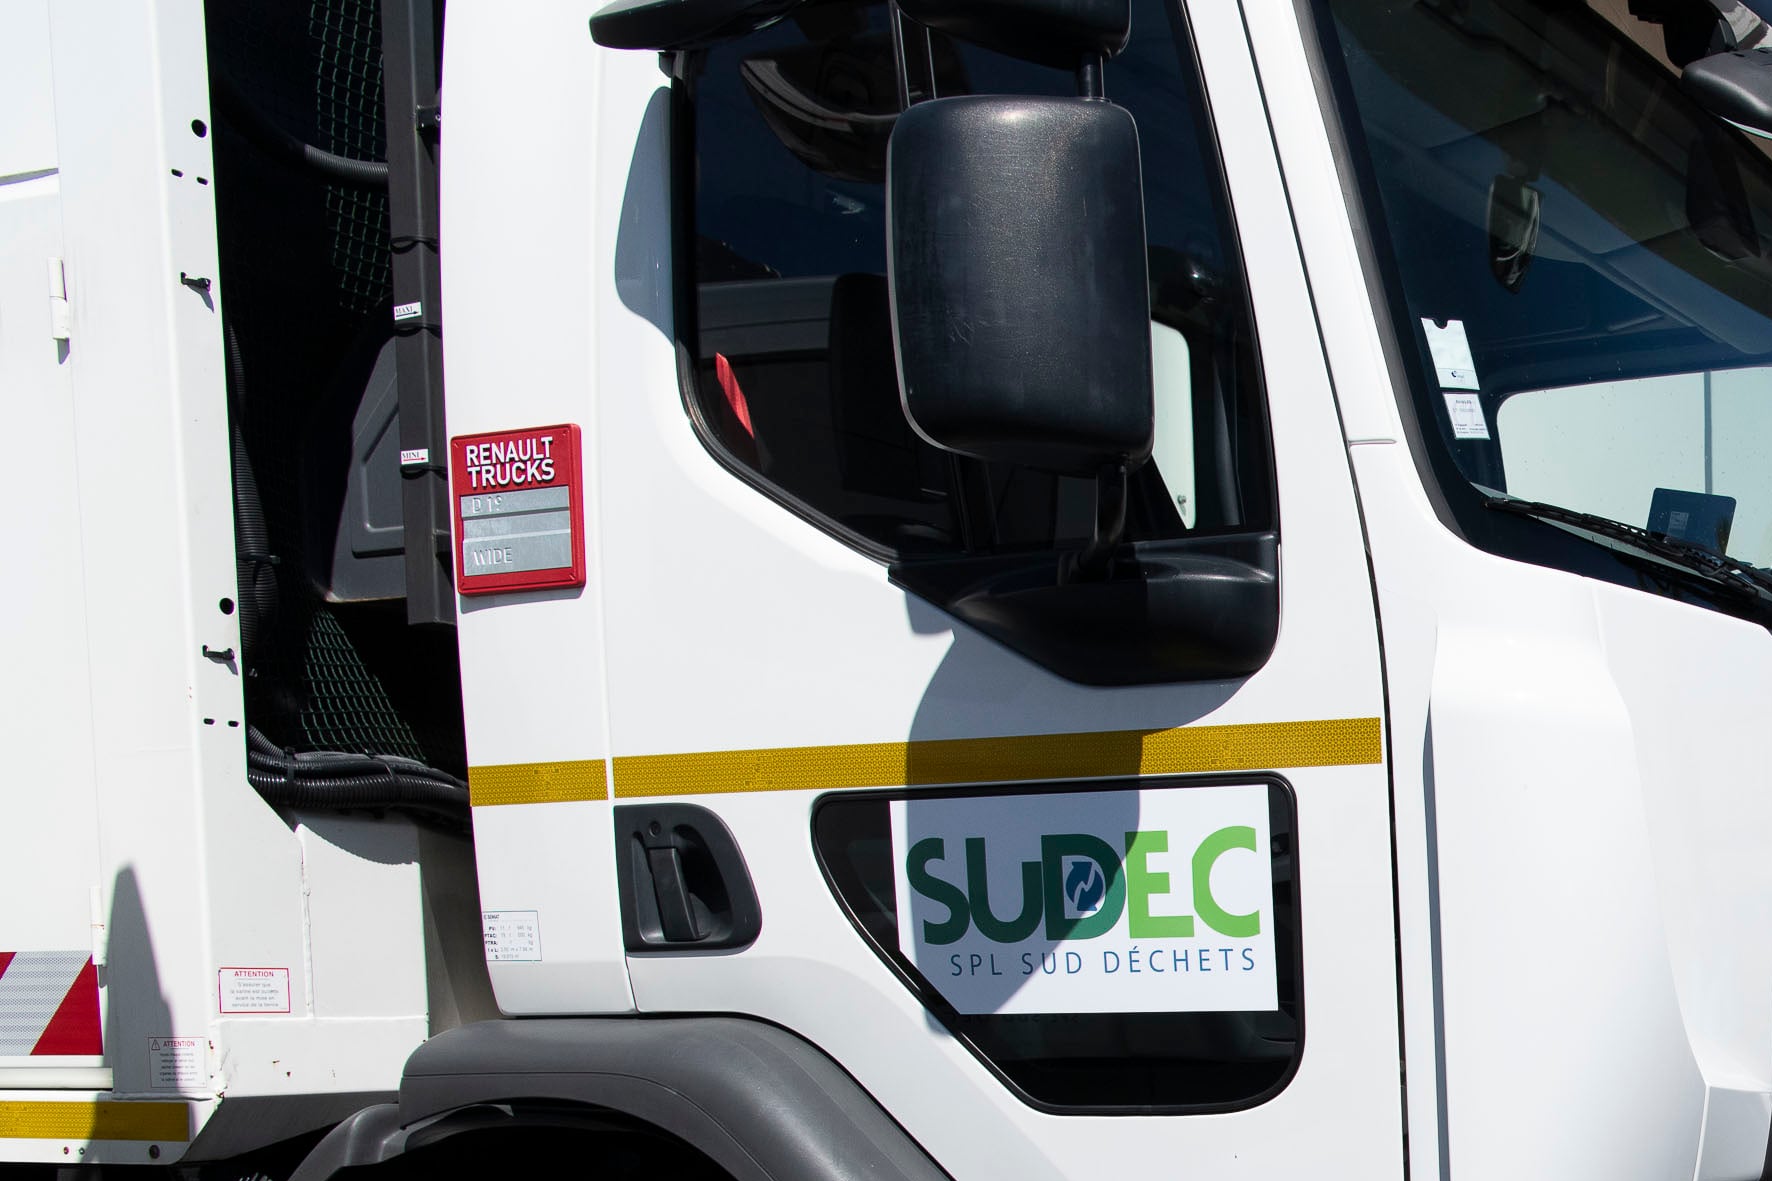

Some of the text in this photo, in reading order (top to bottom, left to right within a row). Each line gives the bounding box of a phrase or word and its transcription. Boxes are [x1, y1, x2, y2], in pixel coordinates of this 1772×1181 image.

[466, 436, 553, 467] RENAULT
[467, 459, 555, 488] TRUCKS
[906, 825, 1261, 946] SUDEC
[950, 946, 1256, 977] SPL SUD DÉCHETS
